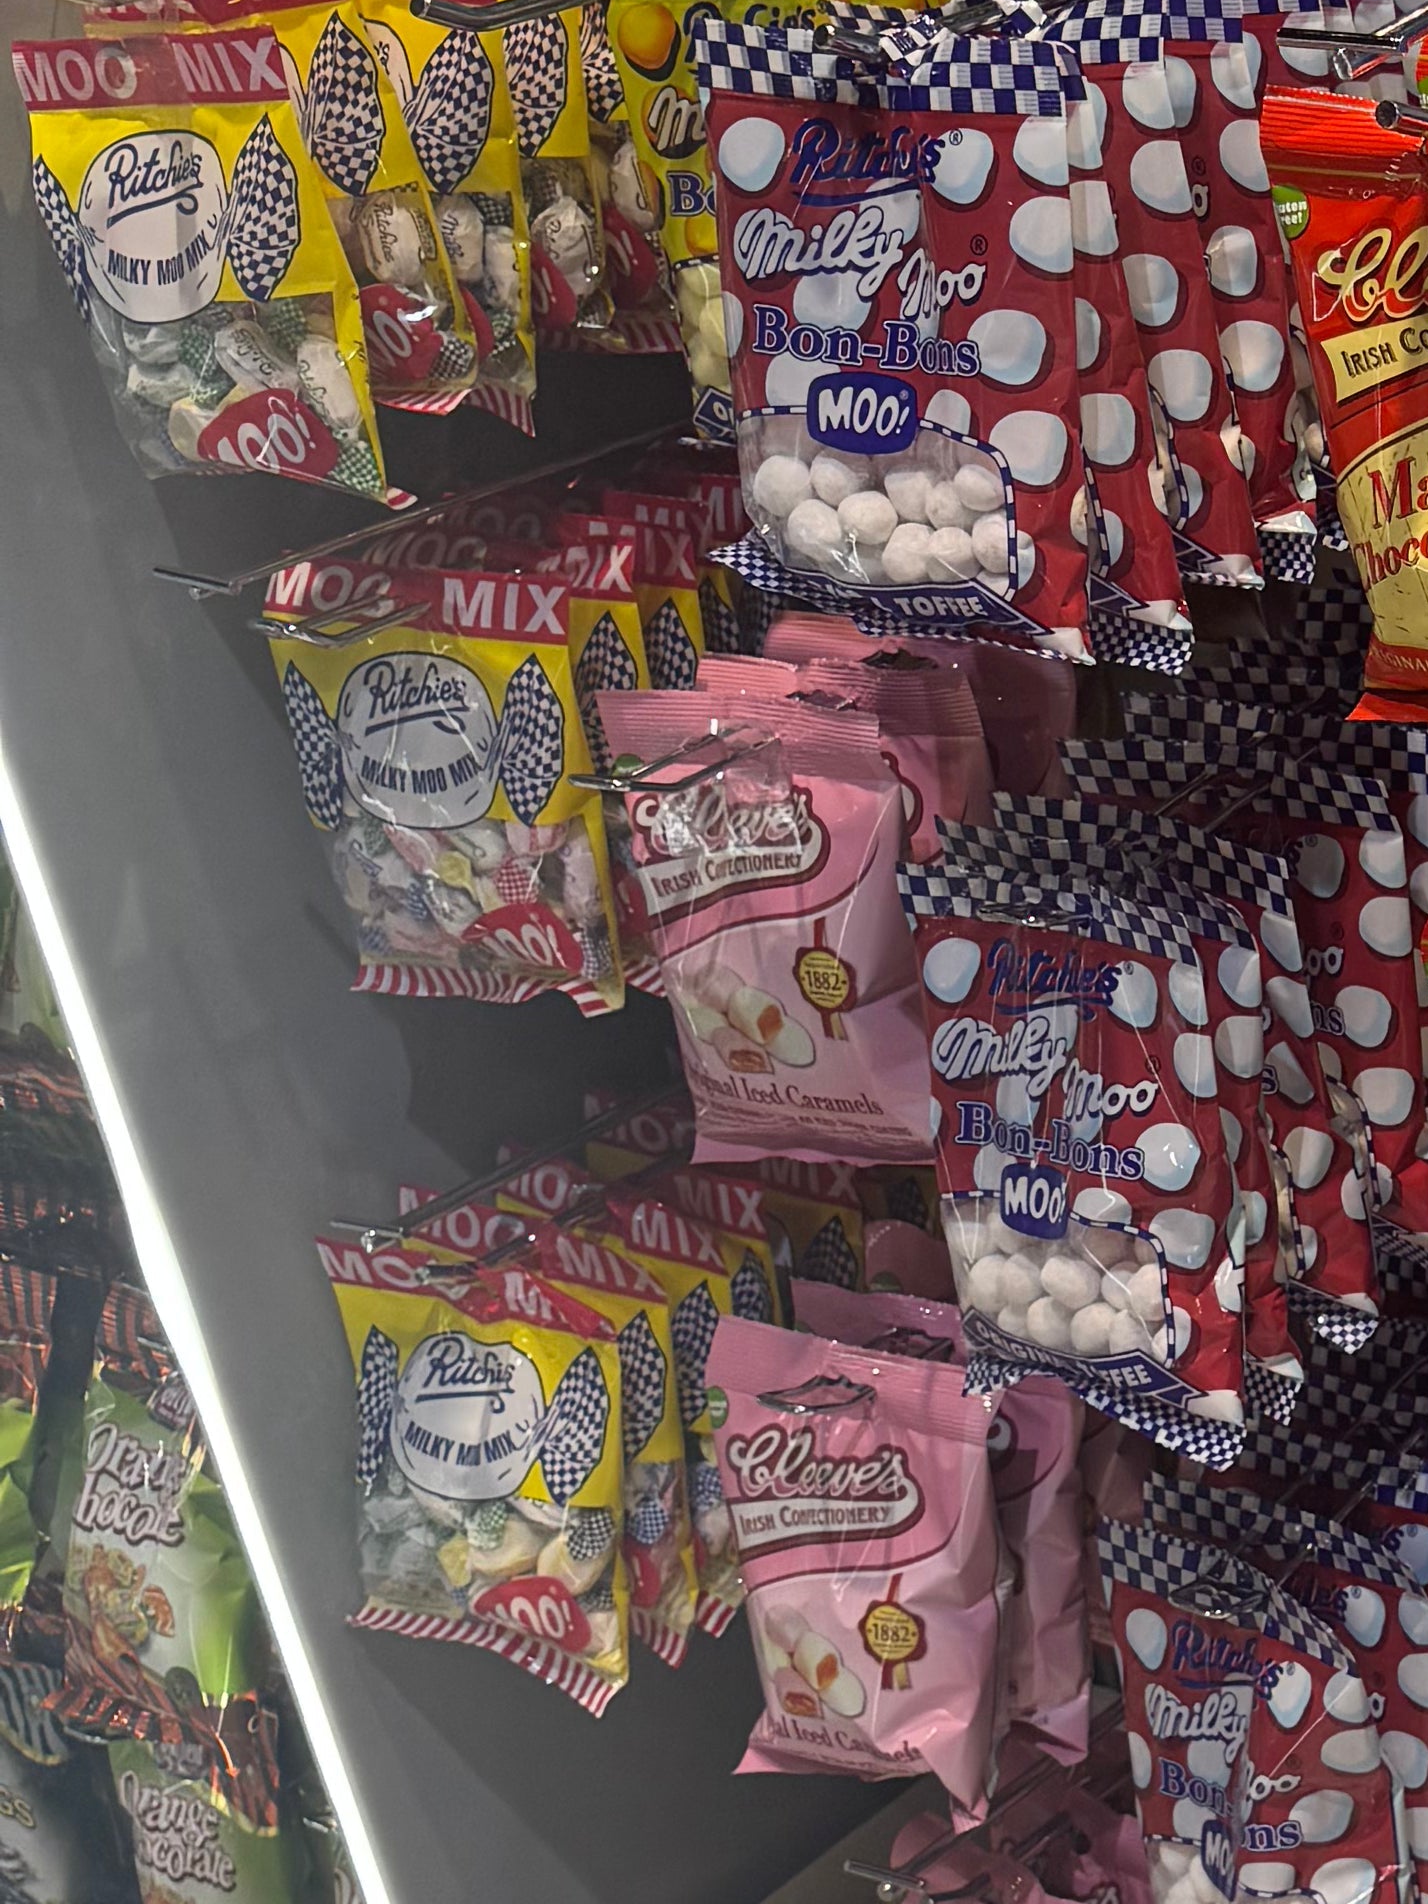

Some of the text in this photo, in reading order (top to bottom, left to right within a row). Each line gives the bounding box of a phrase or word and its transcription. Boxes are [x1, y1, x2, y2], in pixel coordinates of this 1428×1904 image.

[14, 38, 286, 101] MOO MIX
[105, 141, 204, 208] Ritchie's
[107, 232, 212, 287] MILKY MIX
[738, 206, 987, 321] Milky Moo
[752, 305, 982, 378] Bon-Bons
[1342, 342, 1394, 379] IRISH
[817, 388, 910, 436] MOO!
[900, 595, 989, 619] TOFFEE
[728, 1427, 910, 1498] Cleeve's
